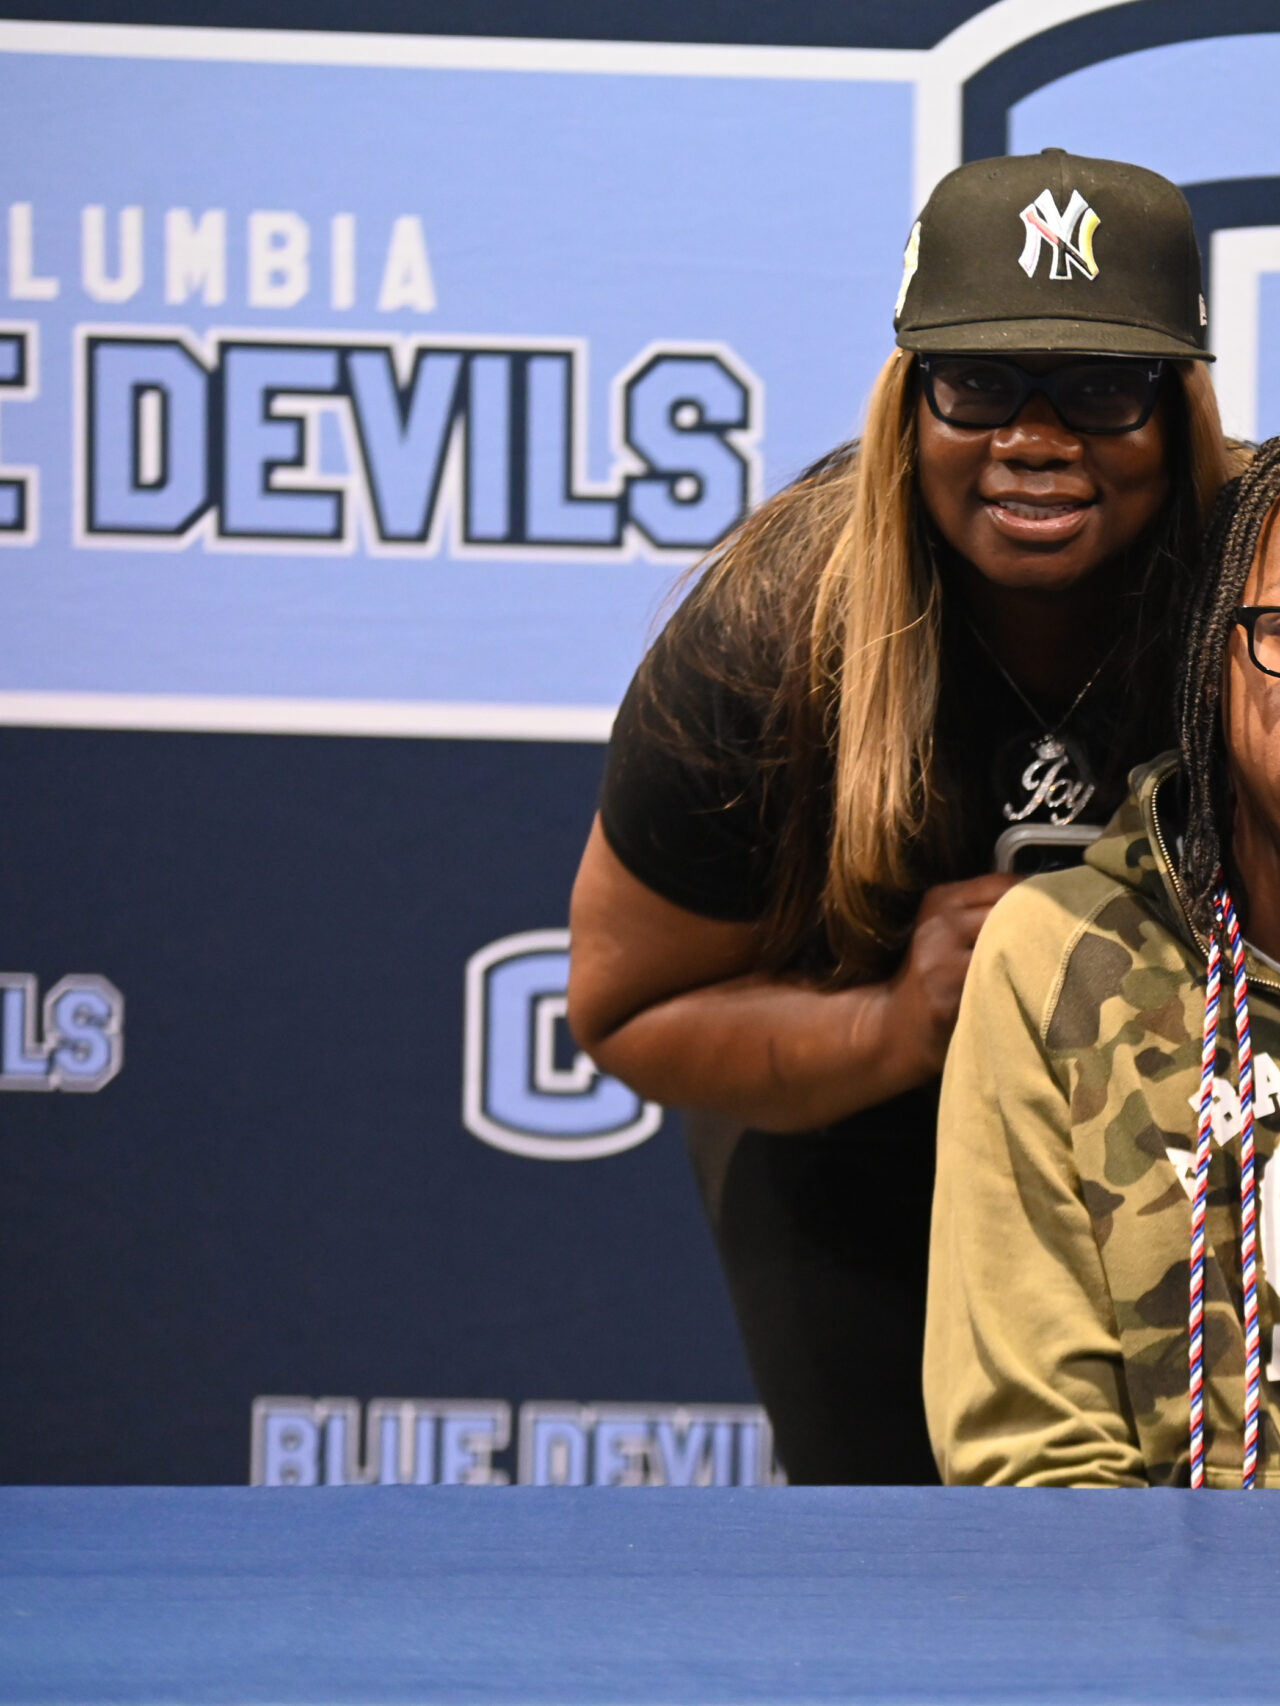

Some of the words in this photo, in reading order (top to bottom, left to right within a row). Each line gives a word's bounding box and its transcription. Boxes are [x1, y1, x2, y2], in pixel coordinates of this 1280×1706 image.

[1017, 187, 1101, 281] NY
[72, 322, 764, 564] DEVILS
[1003, 753, 1096, 826] Joy
[518, 1401, 788, 1486] DEVIL
